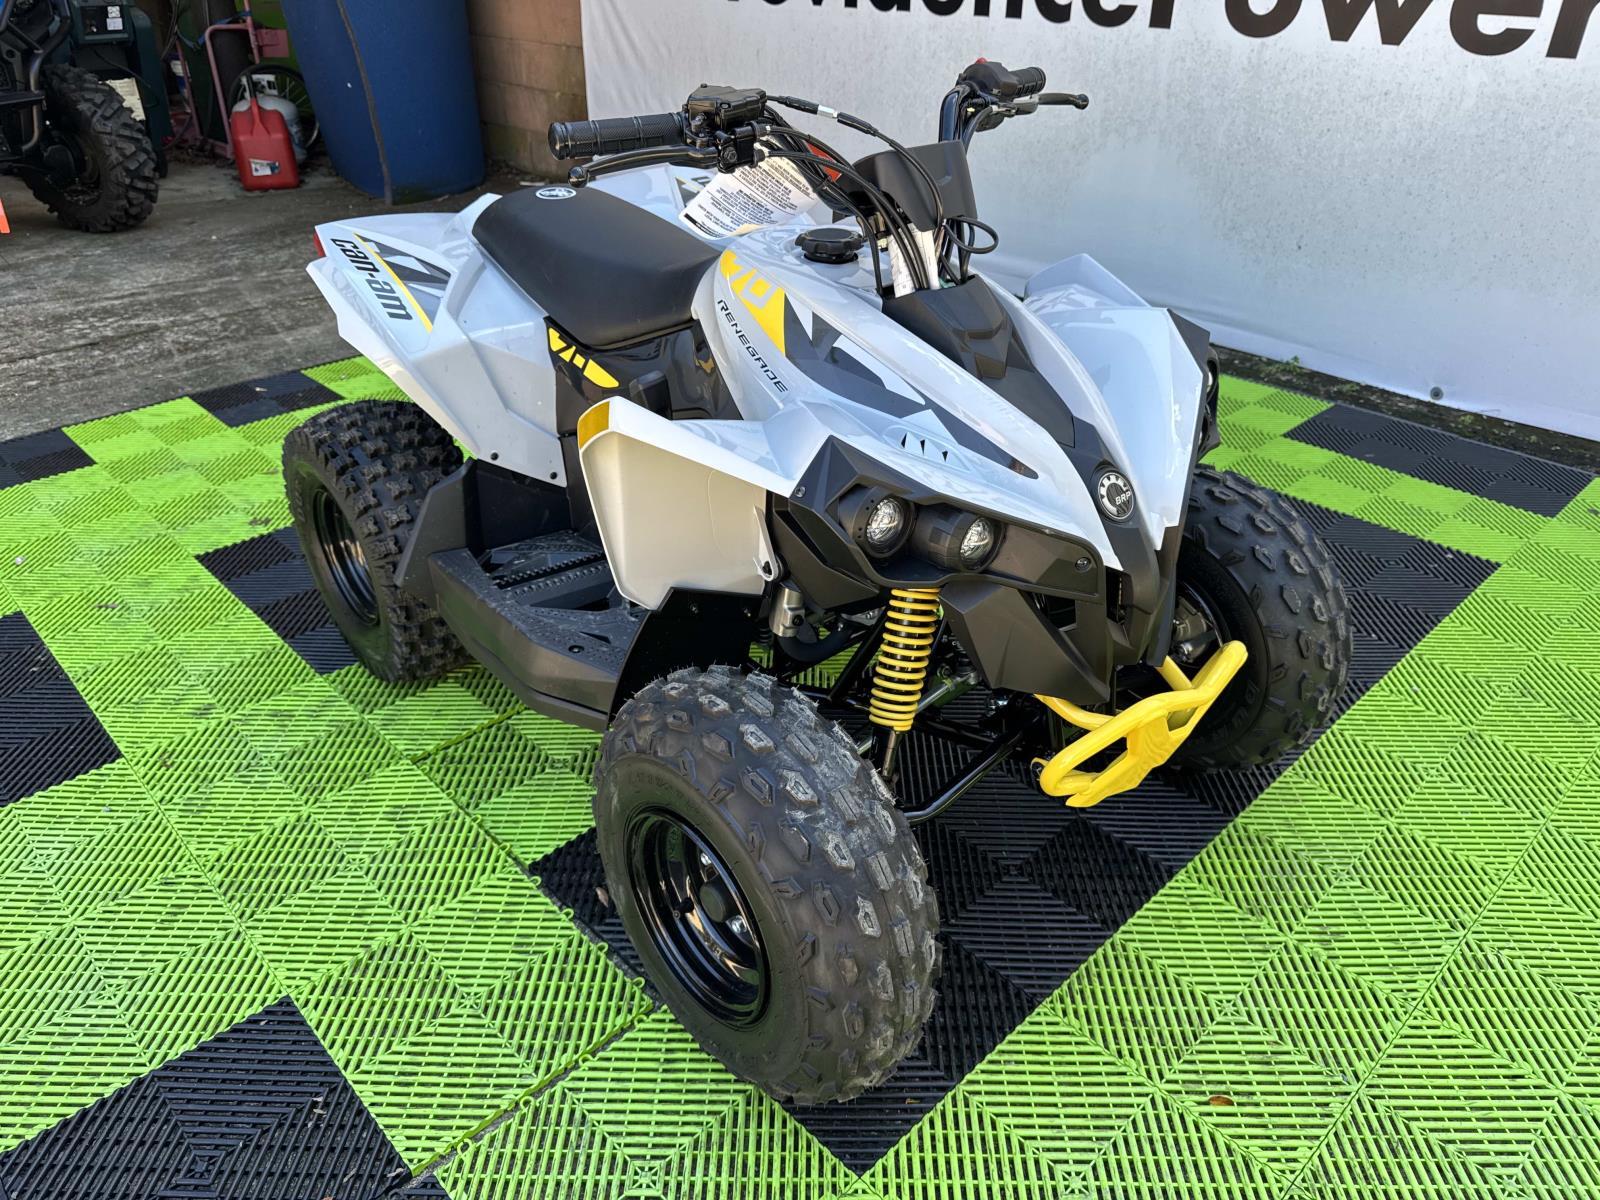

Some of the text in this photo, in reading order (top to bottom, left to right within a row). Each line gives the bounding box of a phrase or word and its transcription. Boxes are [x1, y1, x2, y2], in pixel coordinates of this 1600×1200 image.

[330, 238, 413, 320] can-am
[717, 299, 788, 393] RENEGADE
[1115, 490, 1131, 505] BRP
